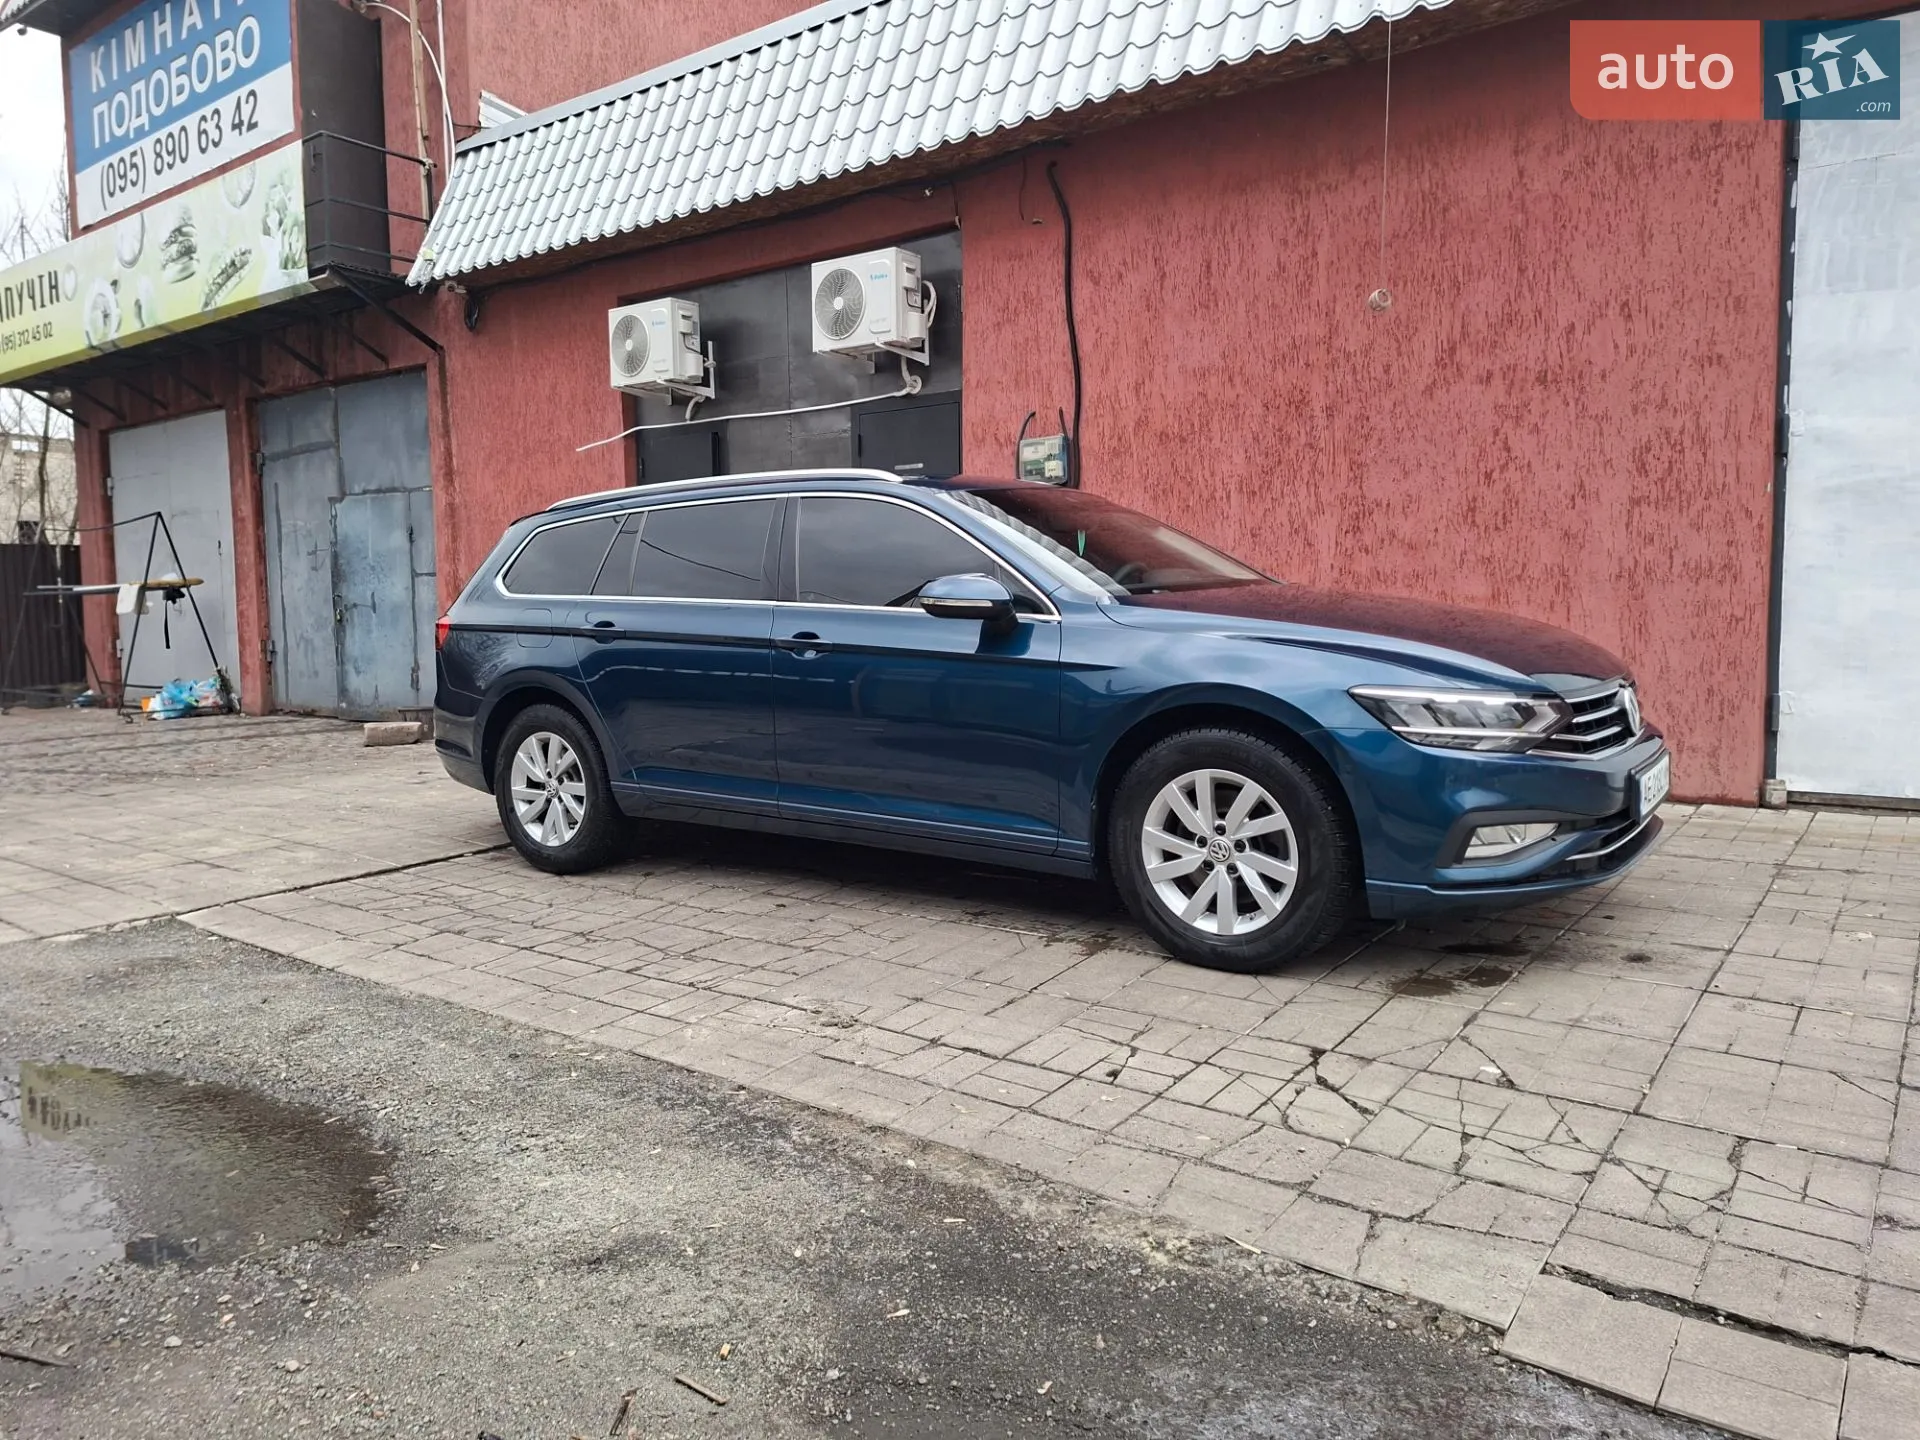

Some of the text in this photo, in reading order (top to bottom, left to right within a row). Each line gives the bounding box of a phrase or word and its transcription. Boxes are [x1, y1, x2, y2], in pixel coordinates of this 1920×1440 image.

[90, 0, 244, 93] КІМНА
[93, 16, 261, 149] ПОДОБОВО
[100, 89, 259, 210] (095) 890 63 42
[43, 321, 54, 339] 02
